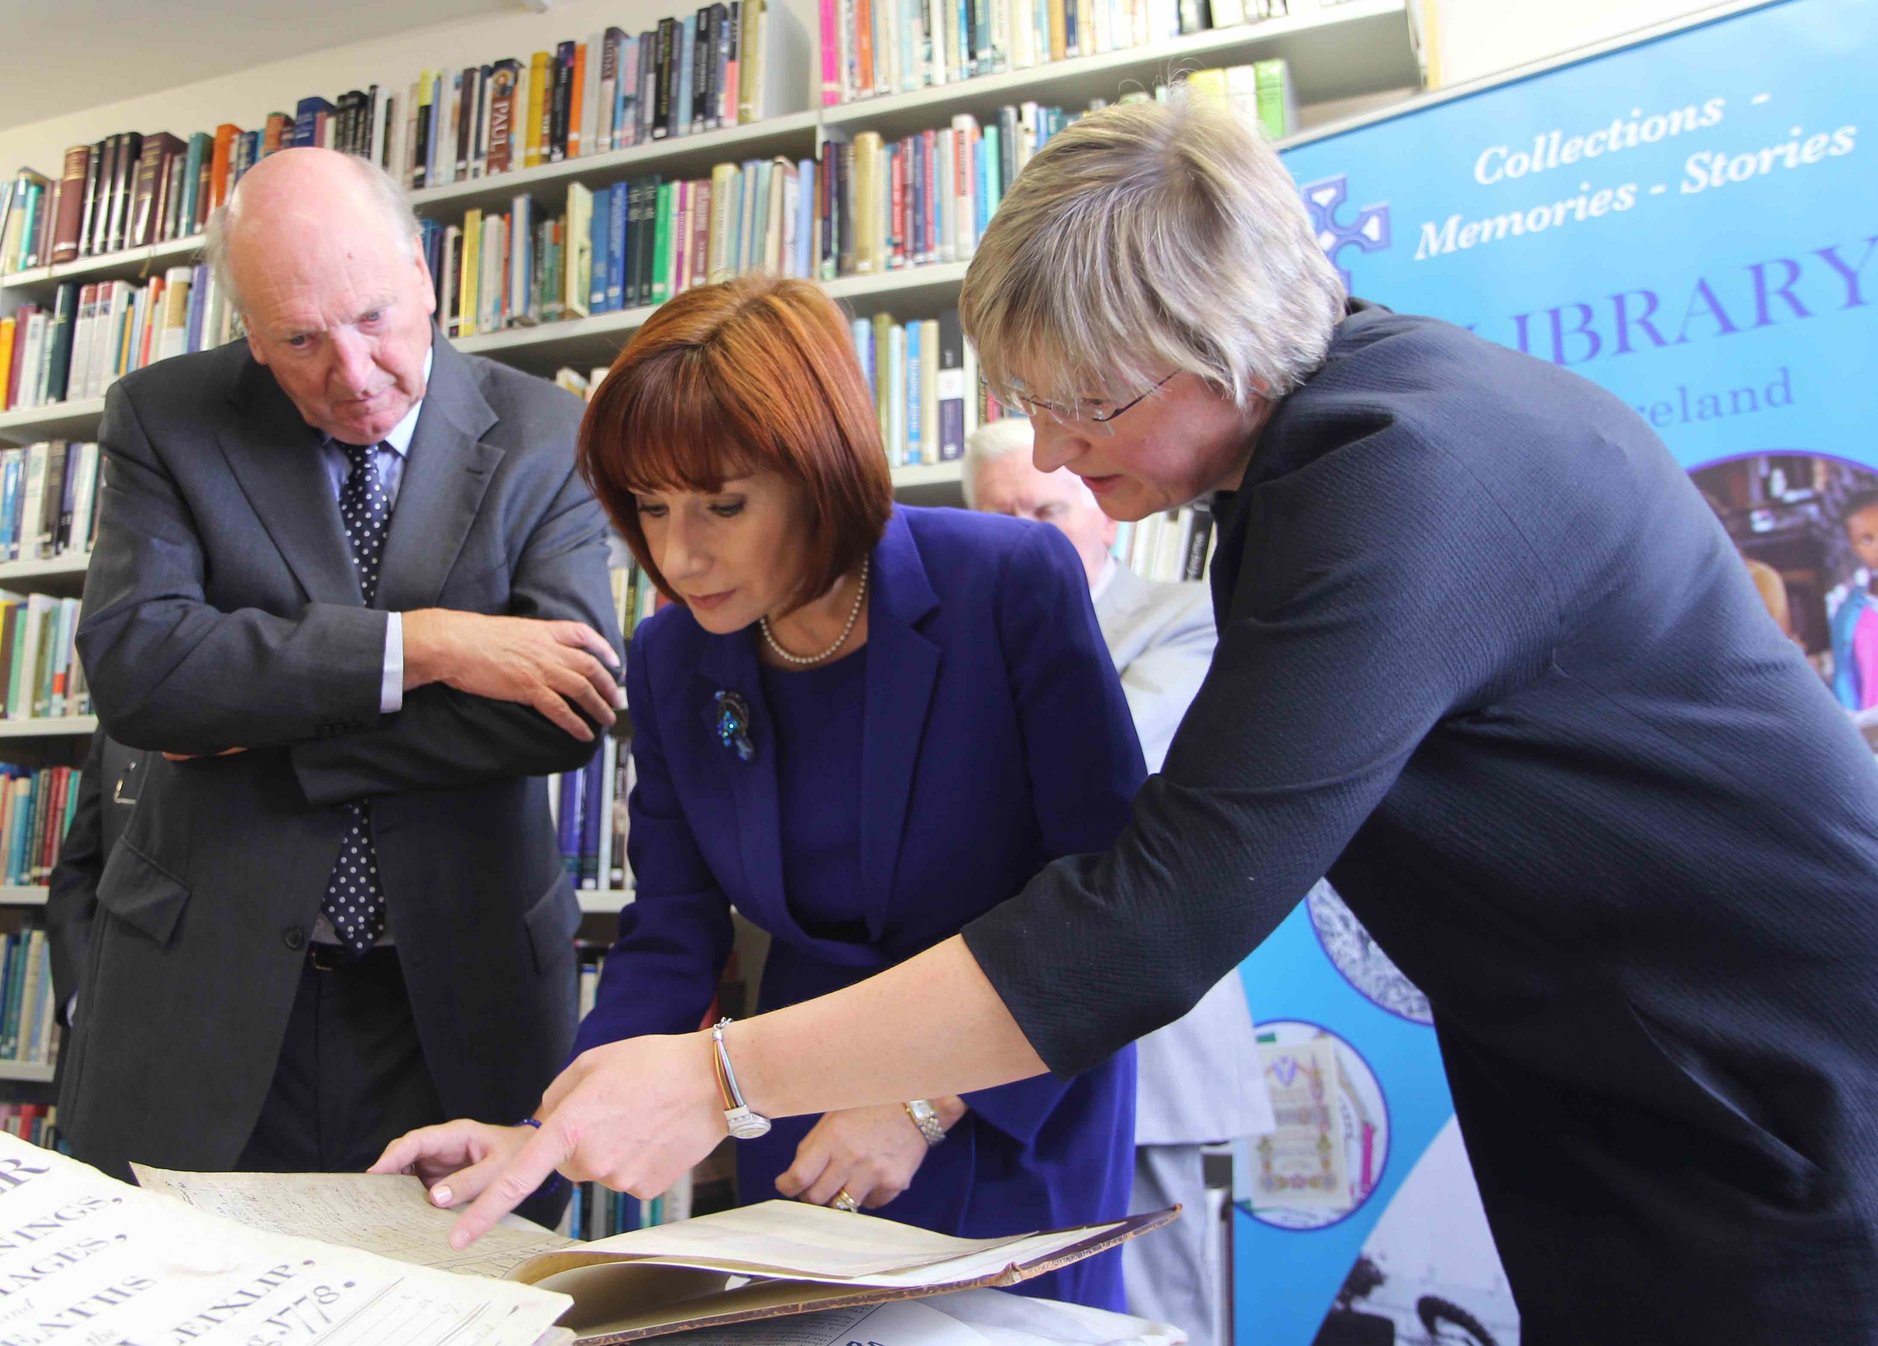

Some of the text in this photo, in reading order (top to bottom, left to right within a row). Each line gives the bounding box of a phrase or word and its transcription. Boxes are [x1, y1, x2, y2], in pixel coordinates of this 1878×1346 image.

[489, 101, 510, 152] PAUL
[1474, 97, 1727, 186] Collections
[1413, 181, 1638, 261] Memories
[1680, 125, 1858, 196] Stories
[1461, 234, 1878, 367] IBRARY
[1635, 366, 1795, 428] eland
